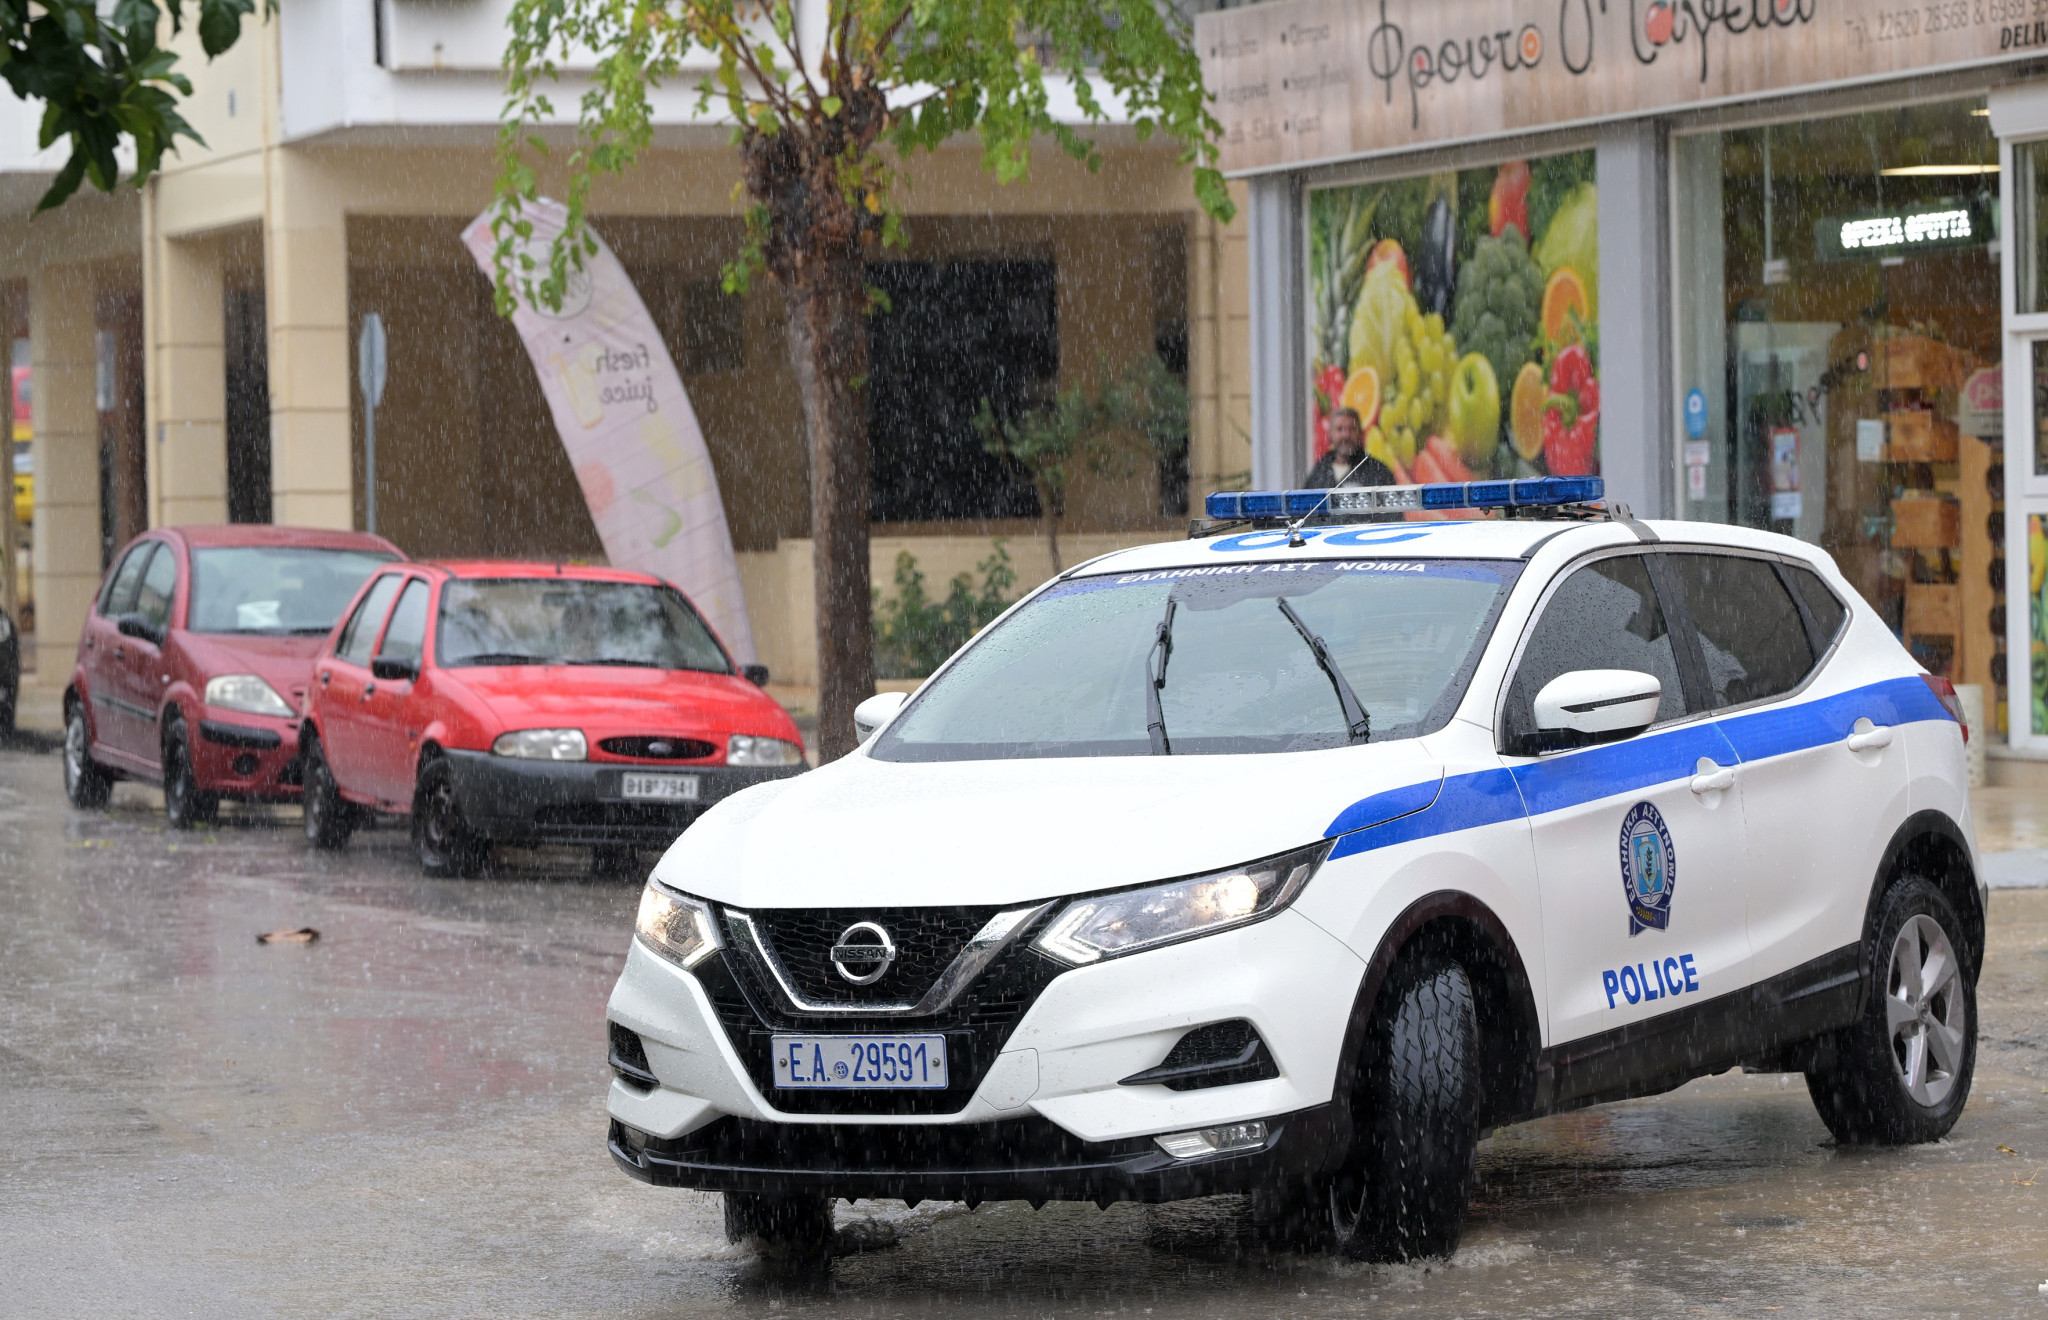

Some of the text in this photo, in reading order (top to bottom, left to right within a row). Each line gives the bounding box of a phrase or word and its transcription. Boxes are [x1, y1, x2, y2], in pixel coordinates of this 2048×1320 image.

[1116, 564, 1260, 584] ΕΛΛΗΝΙΚΗ
[1642, 803, 1676, 896] ΑΣΤΥΝΟΜΙΑ
[835, 948, 887, 959] NISSAN
[1602, 953, 1700, 1009] POLICE
[850, 1042, 929, 1082] 29591
